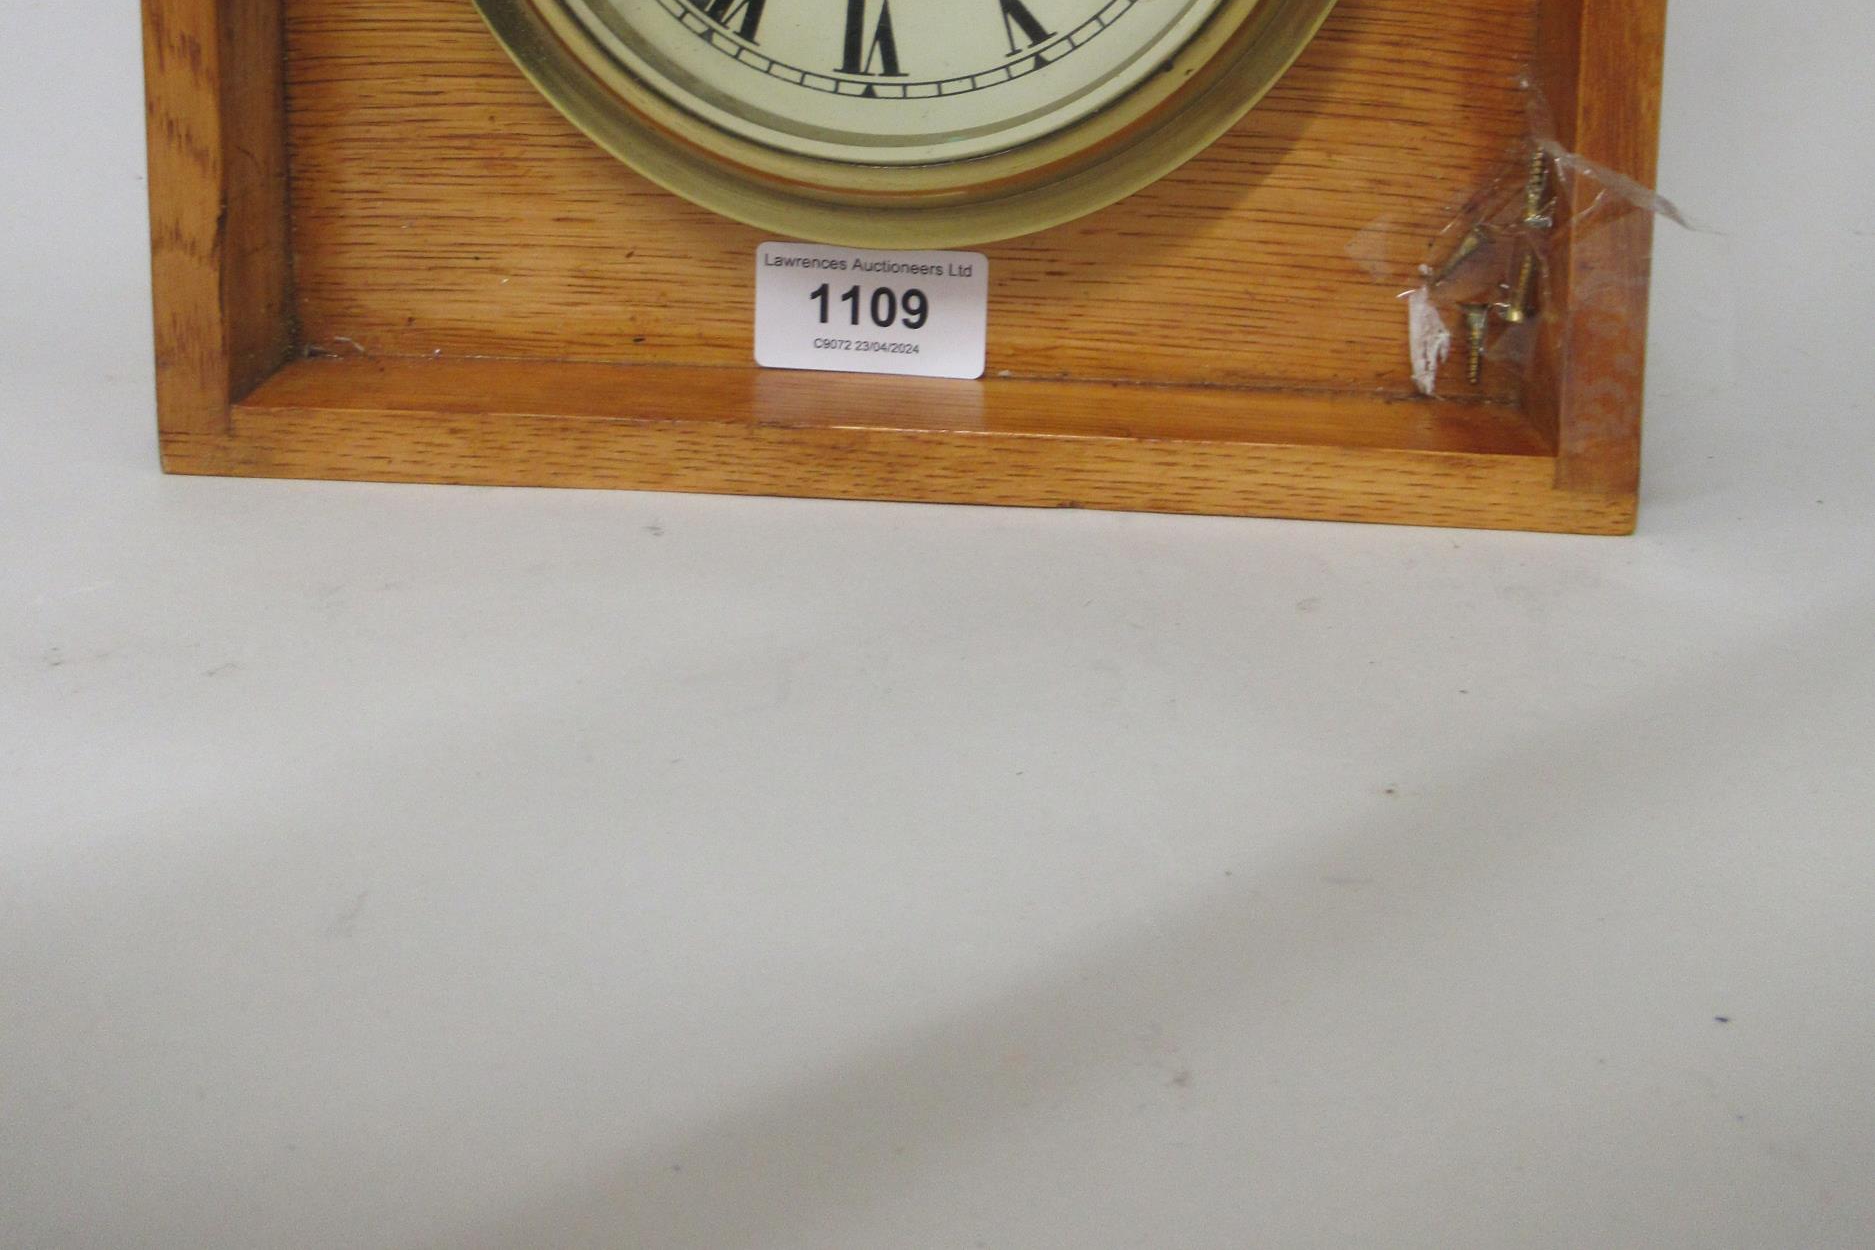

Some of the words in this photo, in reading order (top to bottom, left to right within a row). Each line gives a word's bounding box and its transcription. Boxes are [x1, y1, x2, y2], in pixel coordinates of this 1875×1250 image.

[764, 253, 847, 270] Lawrences
[852, 258, 944, 276] Auctioneers
[948, 263, 973, 277] Ltd
[809, 283, 929, 330] 1109
[813, 337, 852, 351] C9072
[855, 340, 920, 355] 23/04/2024
